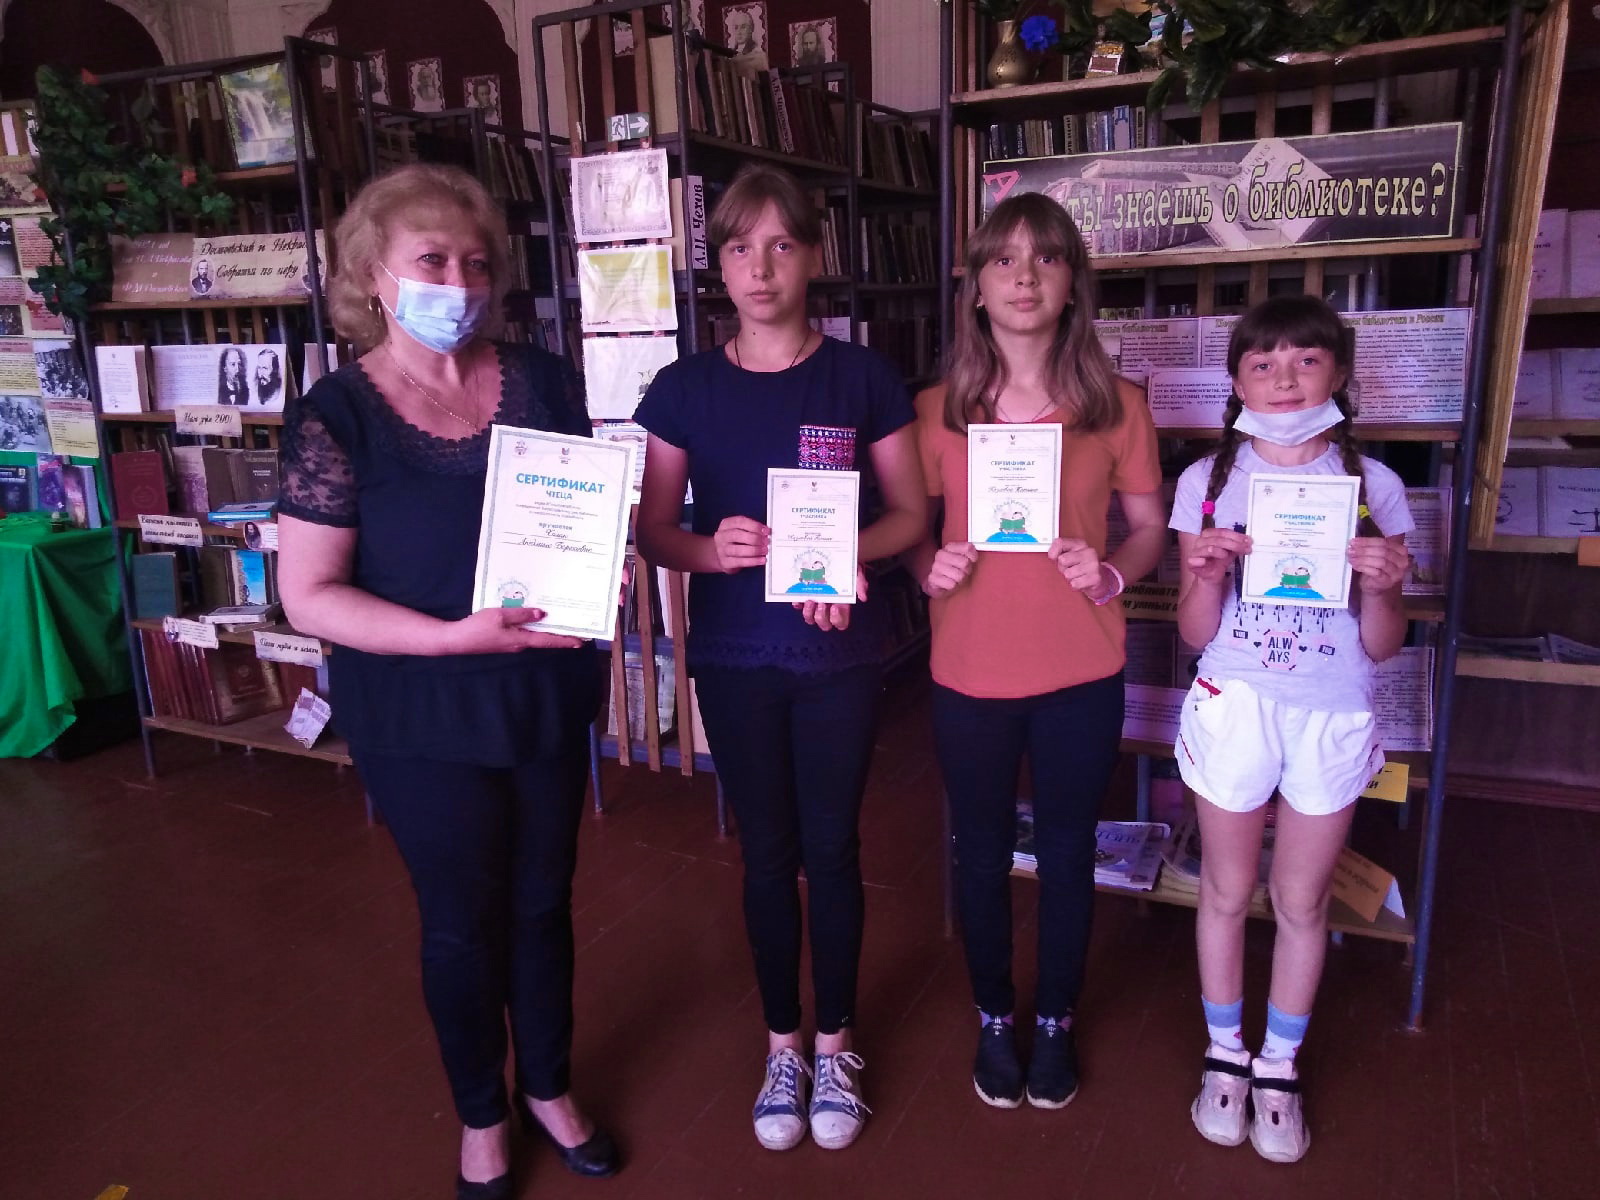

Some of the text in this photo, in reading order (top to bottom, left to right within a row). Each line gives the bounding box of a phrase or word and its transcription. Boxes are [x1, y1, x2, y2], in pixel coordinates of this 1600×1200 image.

[692, 184, 704, 229] Чехов
[1066, 196, 1103, 233] ты
[1112, 186, 1214, 231] знаешь
[1222, 183, 1240, 224] о
[1248, 158, 1446, 223] библиотеке?
[515, 472, 605, 494] СЕРТИФИКАТ
[546, 490, 573, 500] ЧТЕЦА
[1268, 650, 1290, 664] AYS
